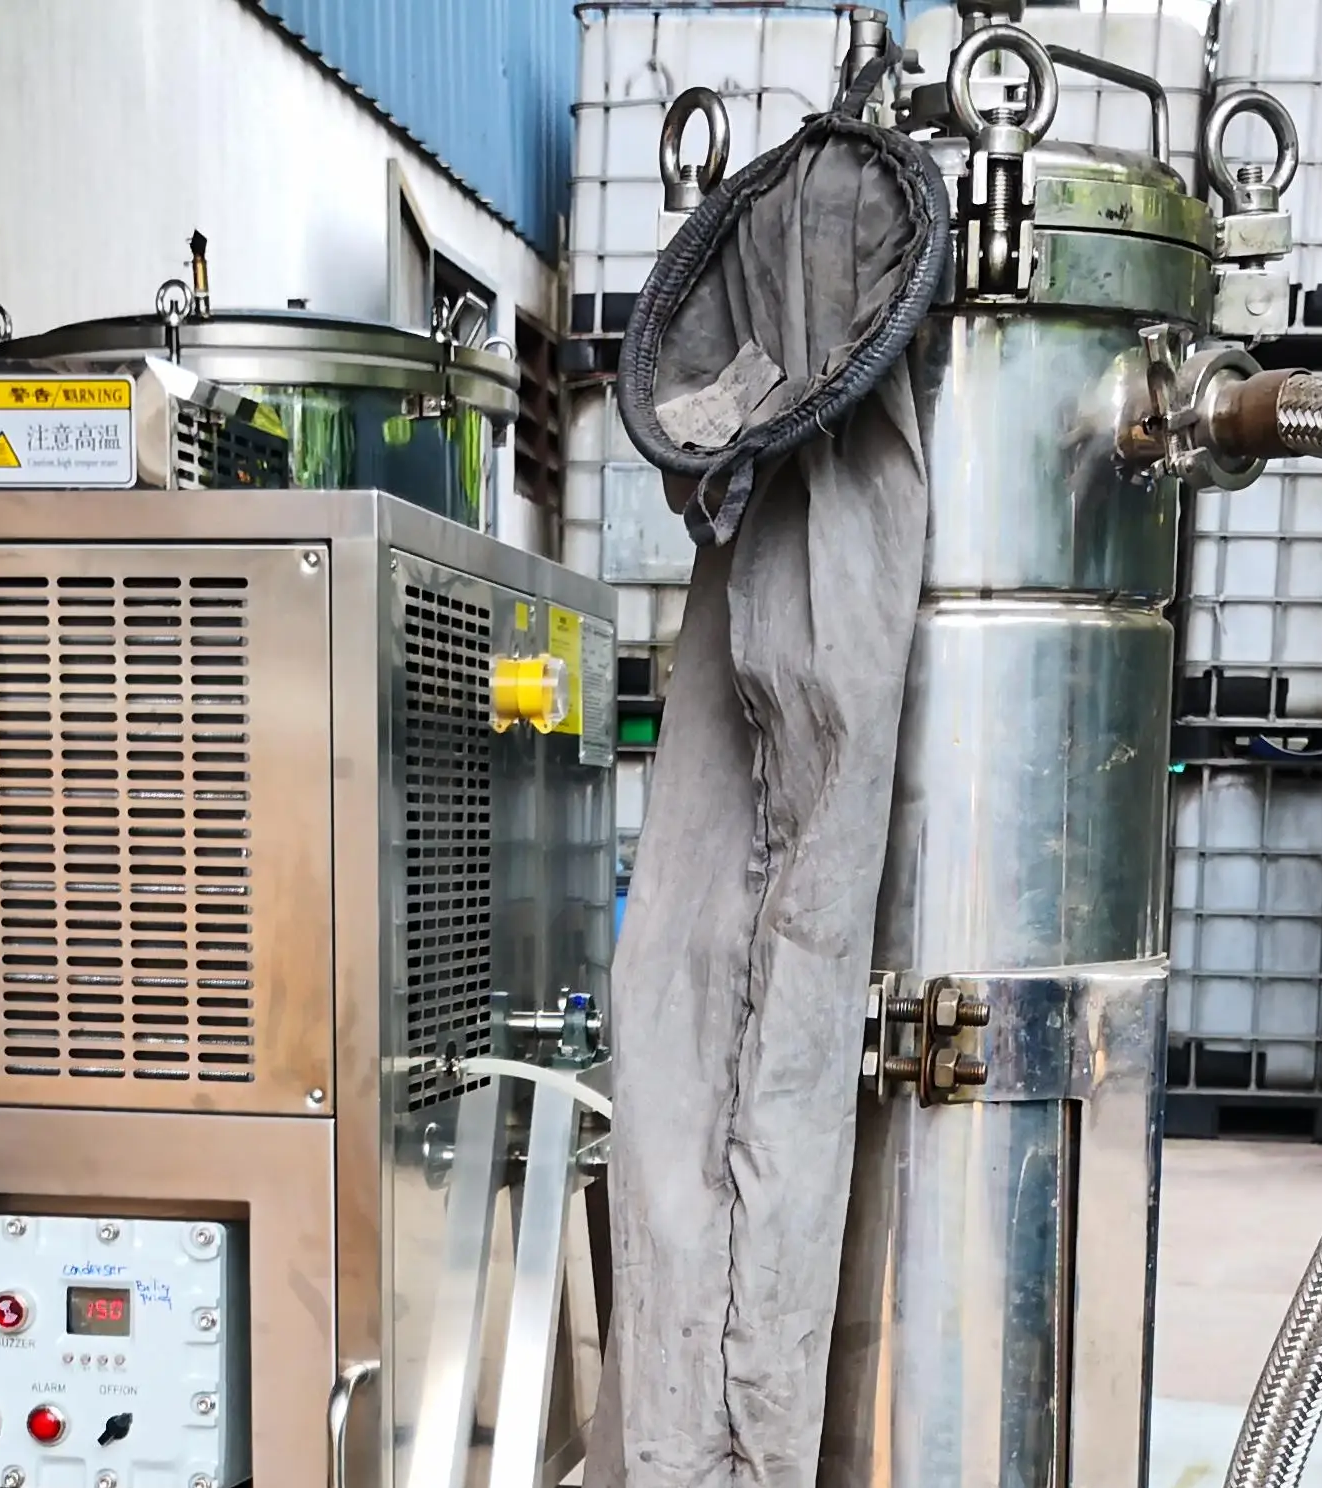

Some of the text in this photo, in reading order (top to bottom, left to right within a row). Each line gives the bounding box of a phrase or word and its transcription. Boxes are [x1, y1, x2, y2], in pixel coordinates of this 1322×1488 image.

[27, 422, 121, 451] 注意高温
[31, 1382, 67, 1393] ALARM
[99, 1384, 138, 1396] OFF/ON
